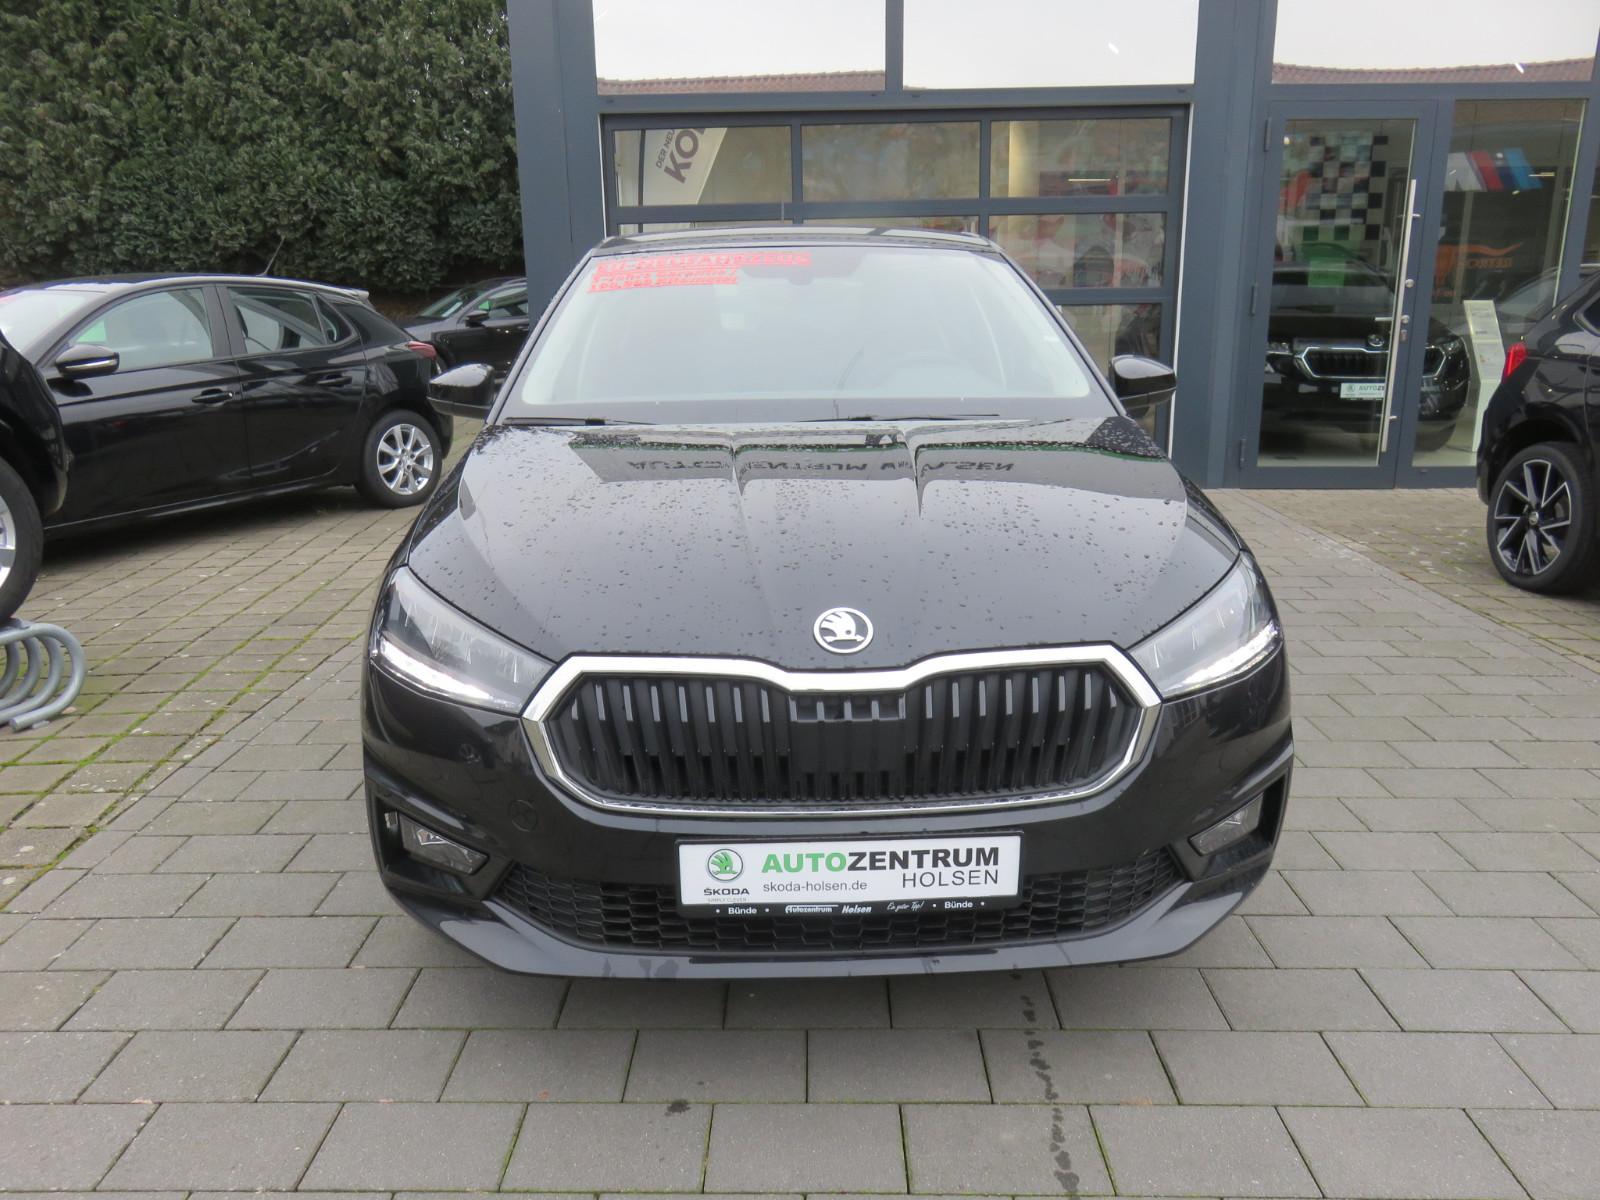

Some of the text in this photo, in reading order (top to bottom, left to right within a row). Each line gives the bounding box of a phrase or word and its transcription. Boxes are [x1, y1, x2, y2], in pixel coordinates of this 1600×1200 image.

[664, 129, 705, 184] KO
[761, 847, 999, 873] AUTOZENTRUM
[763, 880, 867, 892] skoda-holsen.de
[902, 869, 998, 888] HOLSEN
[728, 907, 757, 915] Bünde
[785, 904, 838, 914] Autozentrum
[841, 905, 872, 914] Holsen
[944, 901, 974, 909] Bünde
